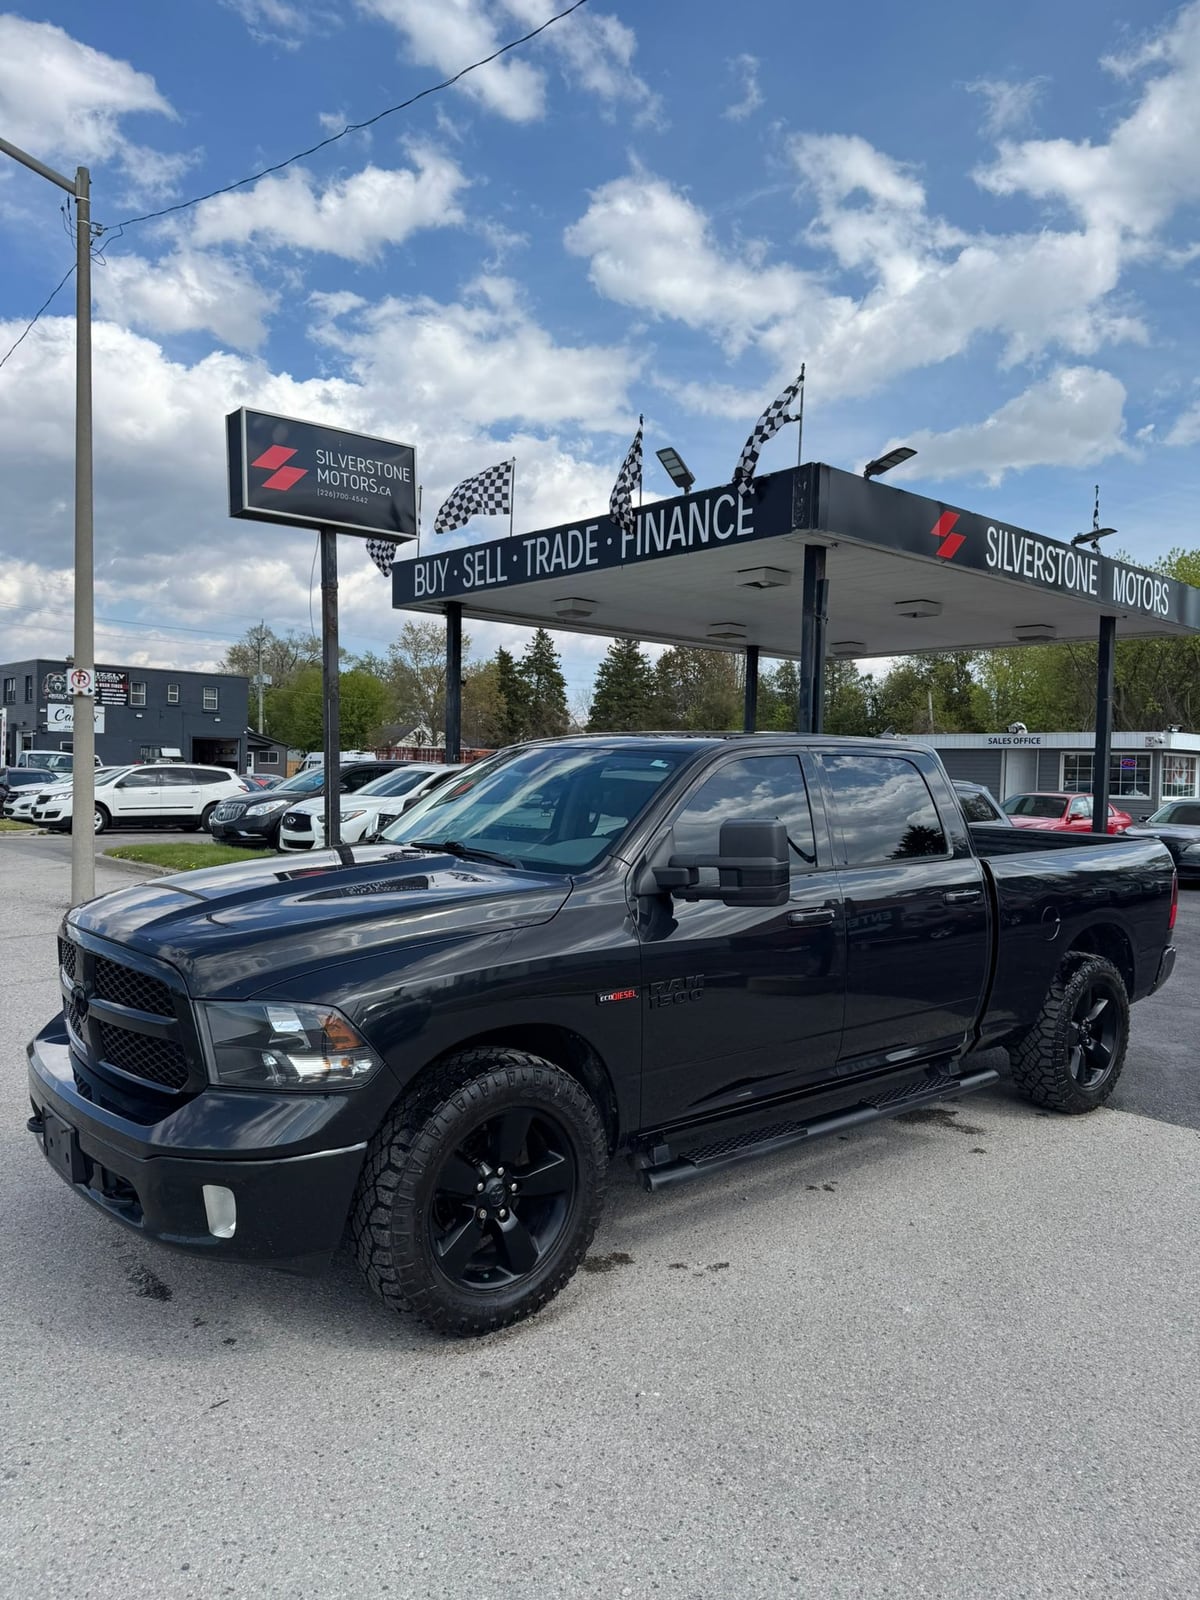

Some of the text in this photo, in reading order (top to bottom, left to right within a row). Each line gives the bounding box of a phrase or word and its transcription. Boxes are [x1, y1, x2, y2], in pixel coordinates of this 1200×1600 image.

[316, 449, 411, 483] SILVERSTONE
[414, 493, 755, 597] BUY SELL TRADE FINANCE
[985, 526, 1170, 616] SILVERSTONE MOTORS
[988, 737, 1041, 745] SALES OFFICE
